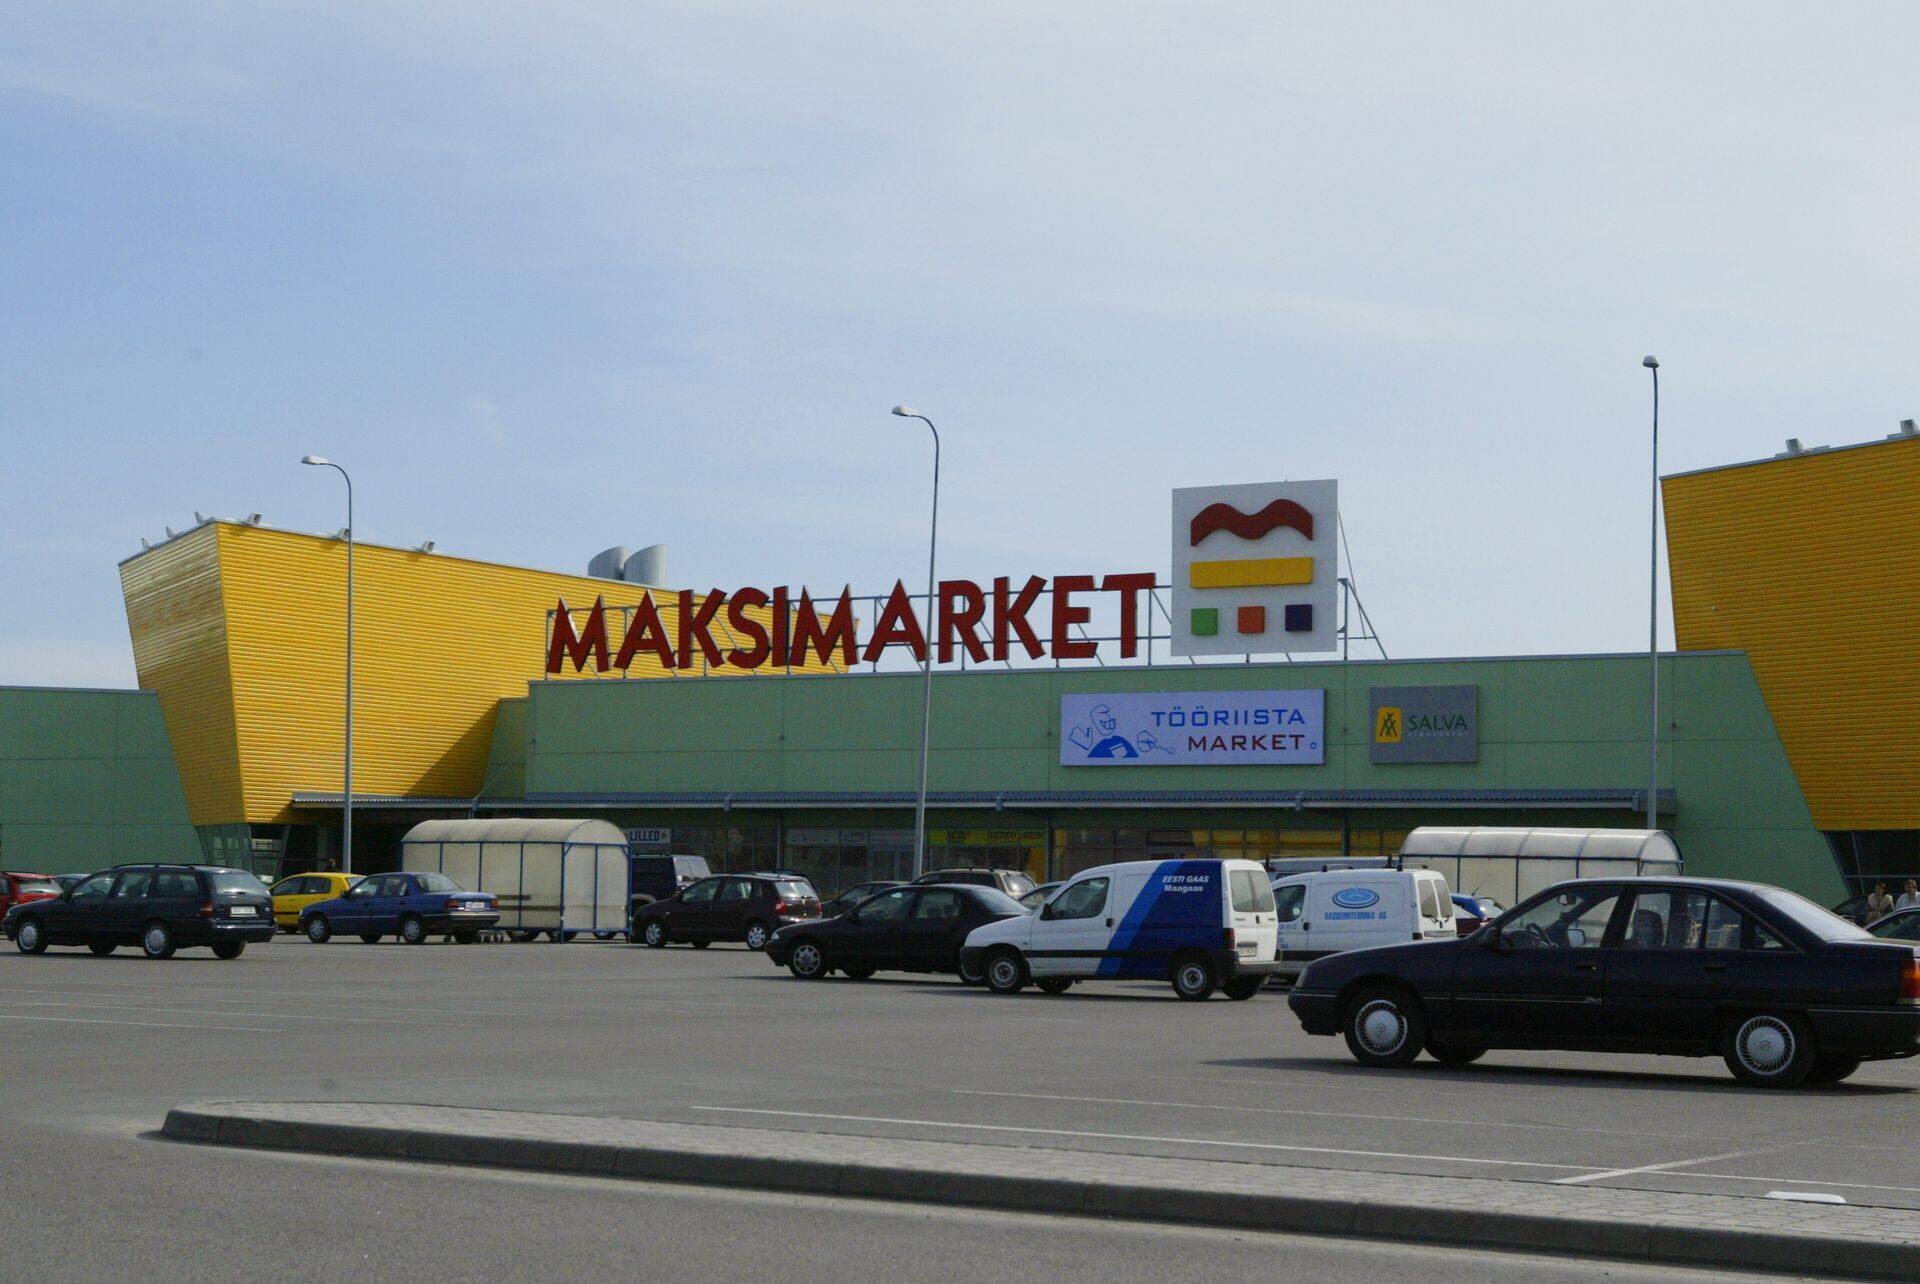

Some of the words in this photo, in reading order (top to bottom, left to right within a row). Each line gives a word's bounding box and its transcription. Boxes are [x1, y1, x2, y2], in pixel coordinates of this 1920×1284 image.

[546, 573, 1156, 673] MAKSIMARKET
[1151, 706, 1305, 727] TÖÖRIISTA
[1408, 714, 1468, 731] SALVA
[1188, 734, 1305, 751] MARKET
[990, 831, 1017, 841] VIDEO
[1162, 875, 1186, 883] EESTI
[1186, 875, 1210, 883] GAAS
[1164, 884, 1204, 893] Maagaas
